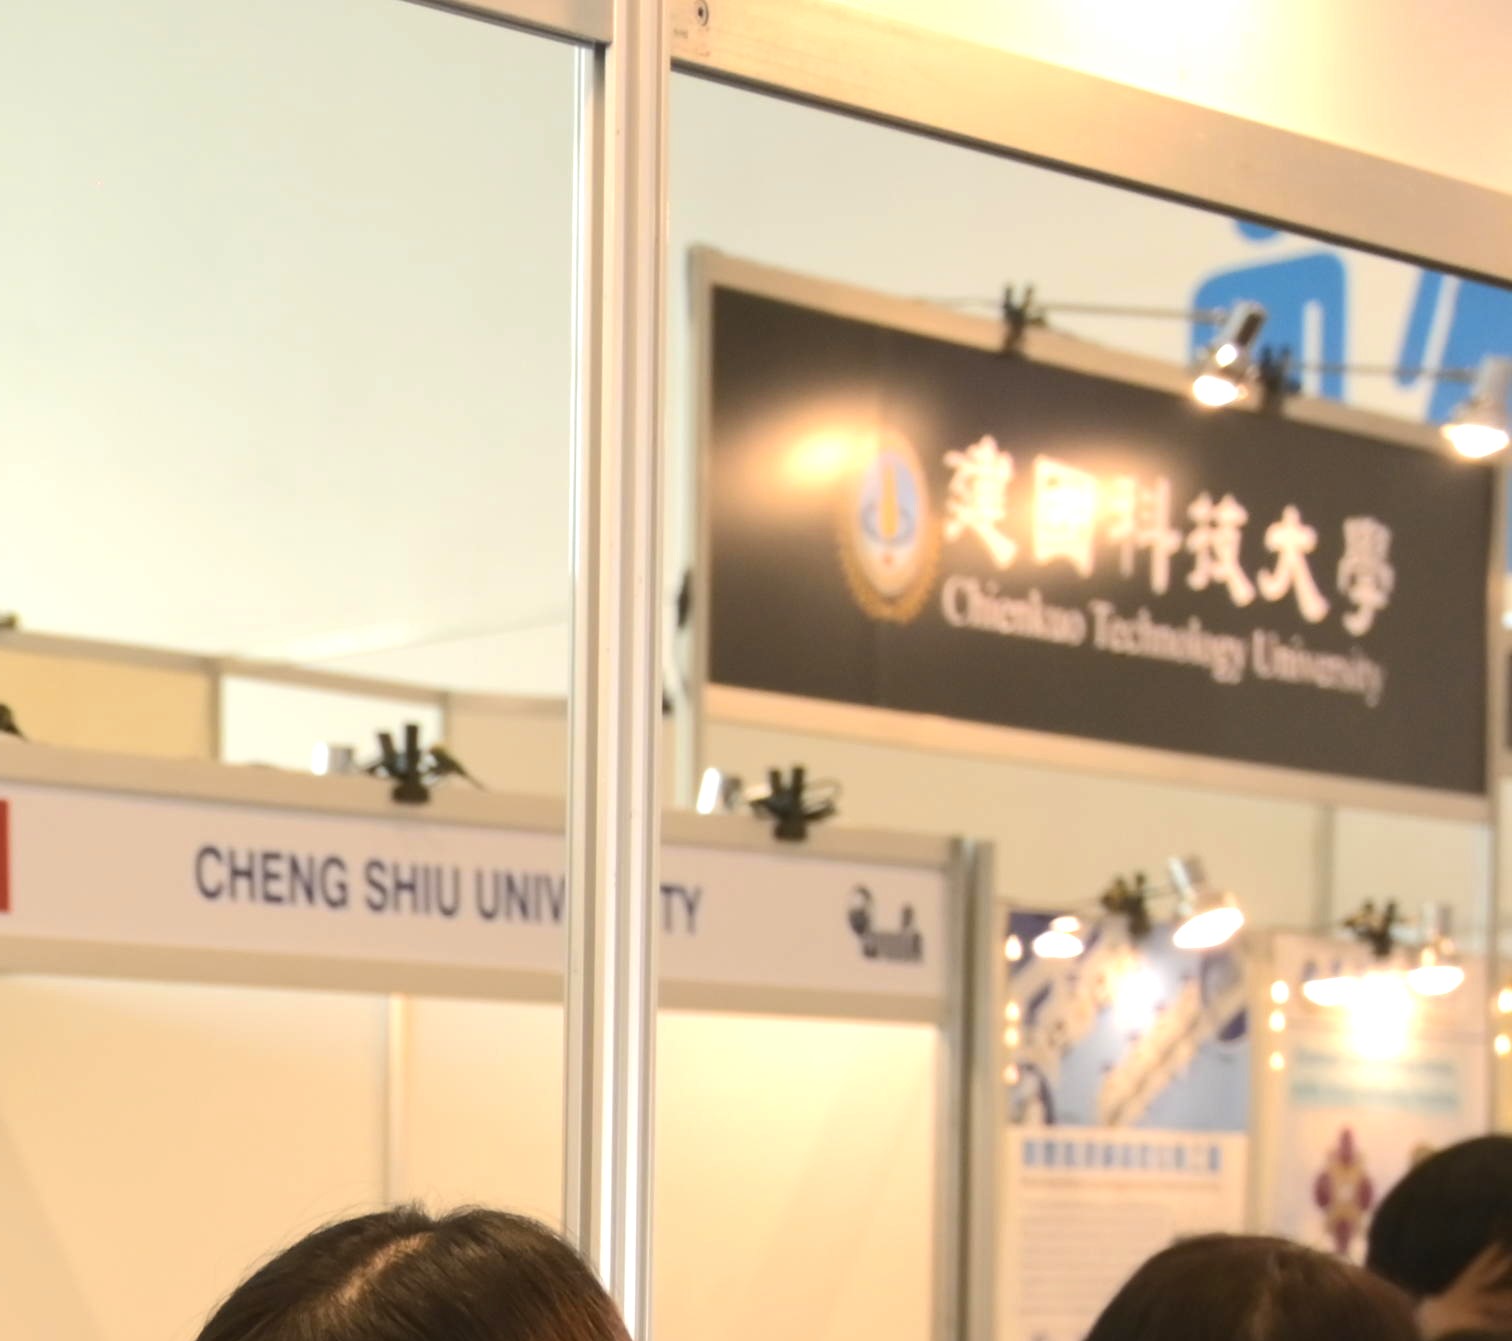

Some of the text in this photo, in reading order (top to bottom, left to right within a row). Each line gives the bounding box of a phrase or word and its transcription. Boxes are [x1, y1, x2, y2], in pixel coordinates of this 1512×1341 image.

[941, 574, 1384, 709] Chienkuo Technology University
[194, 845, 703, 936] CHENG SHIU UNIVTY
